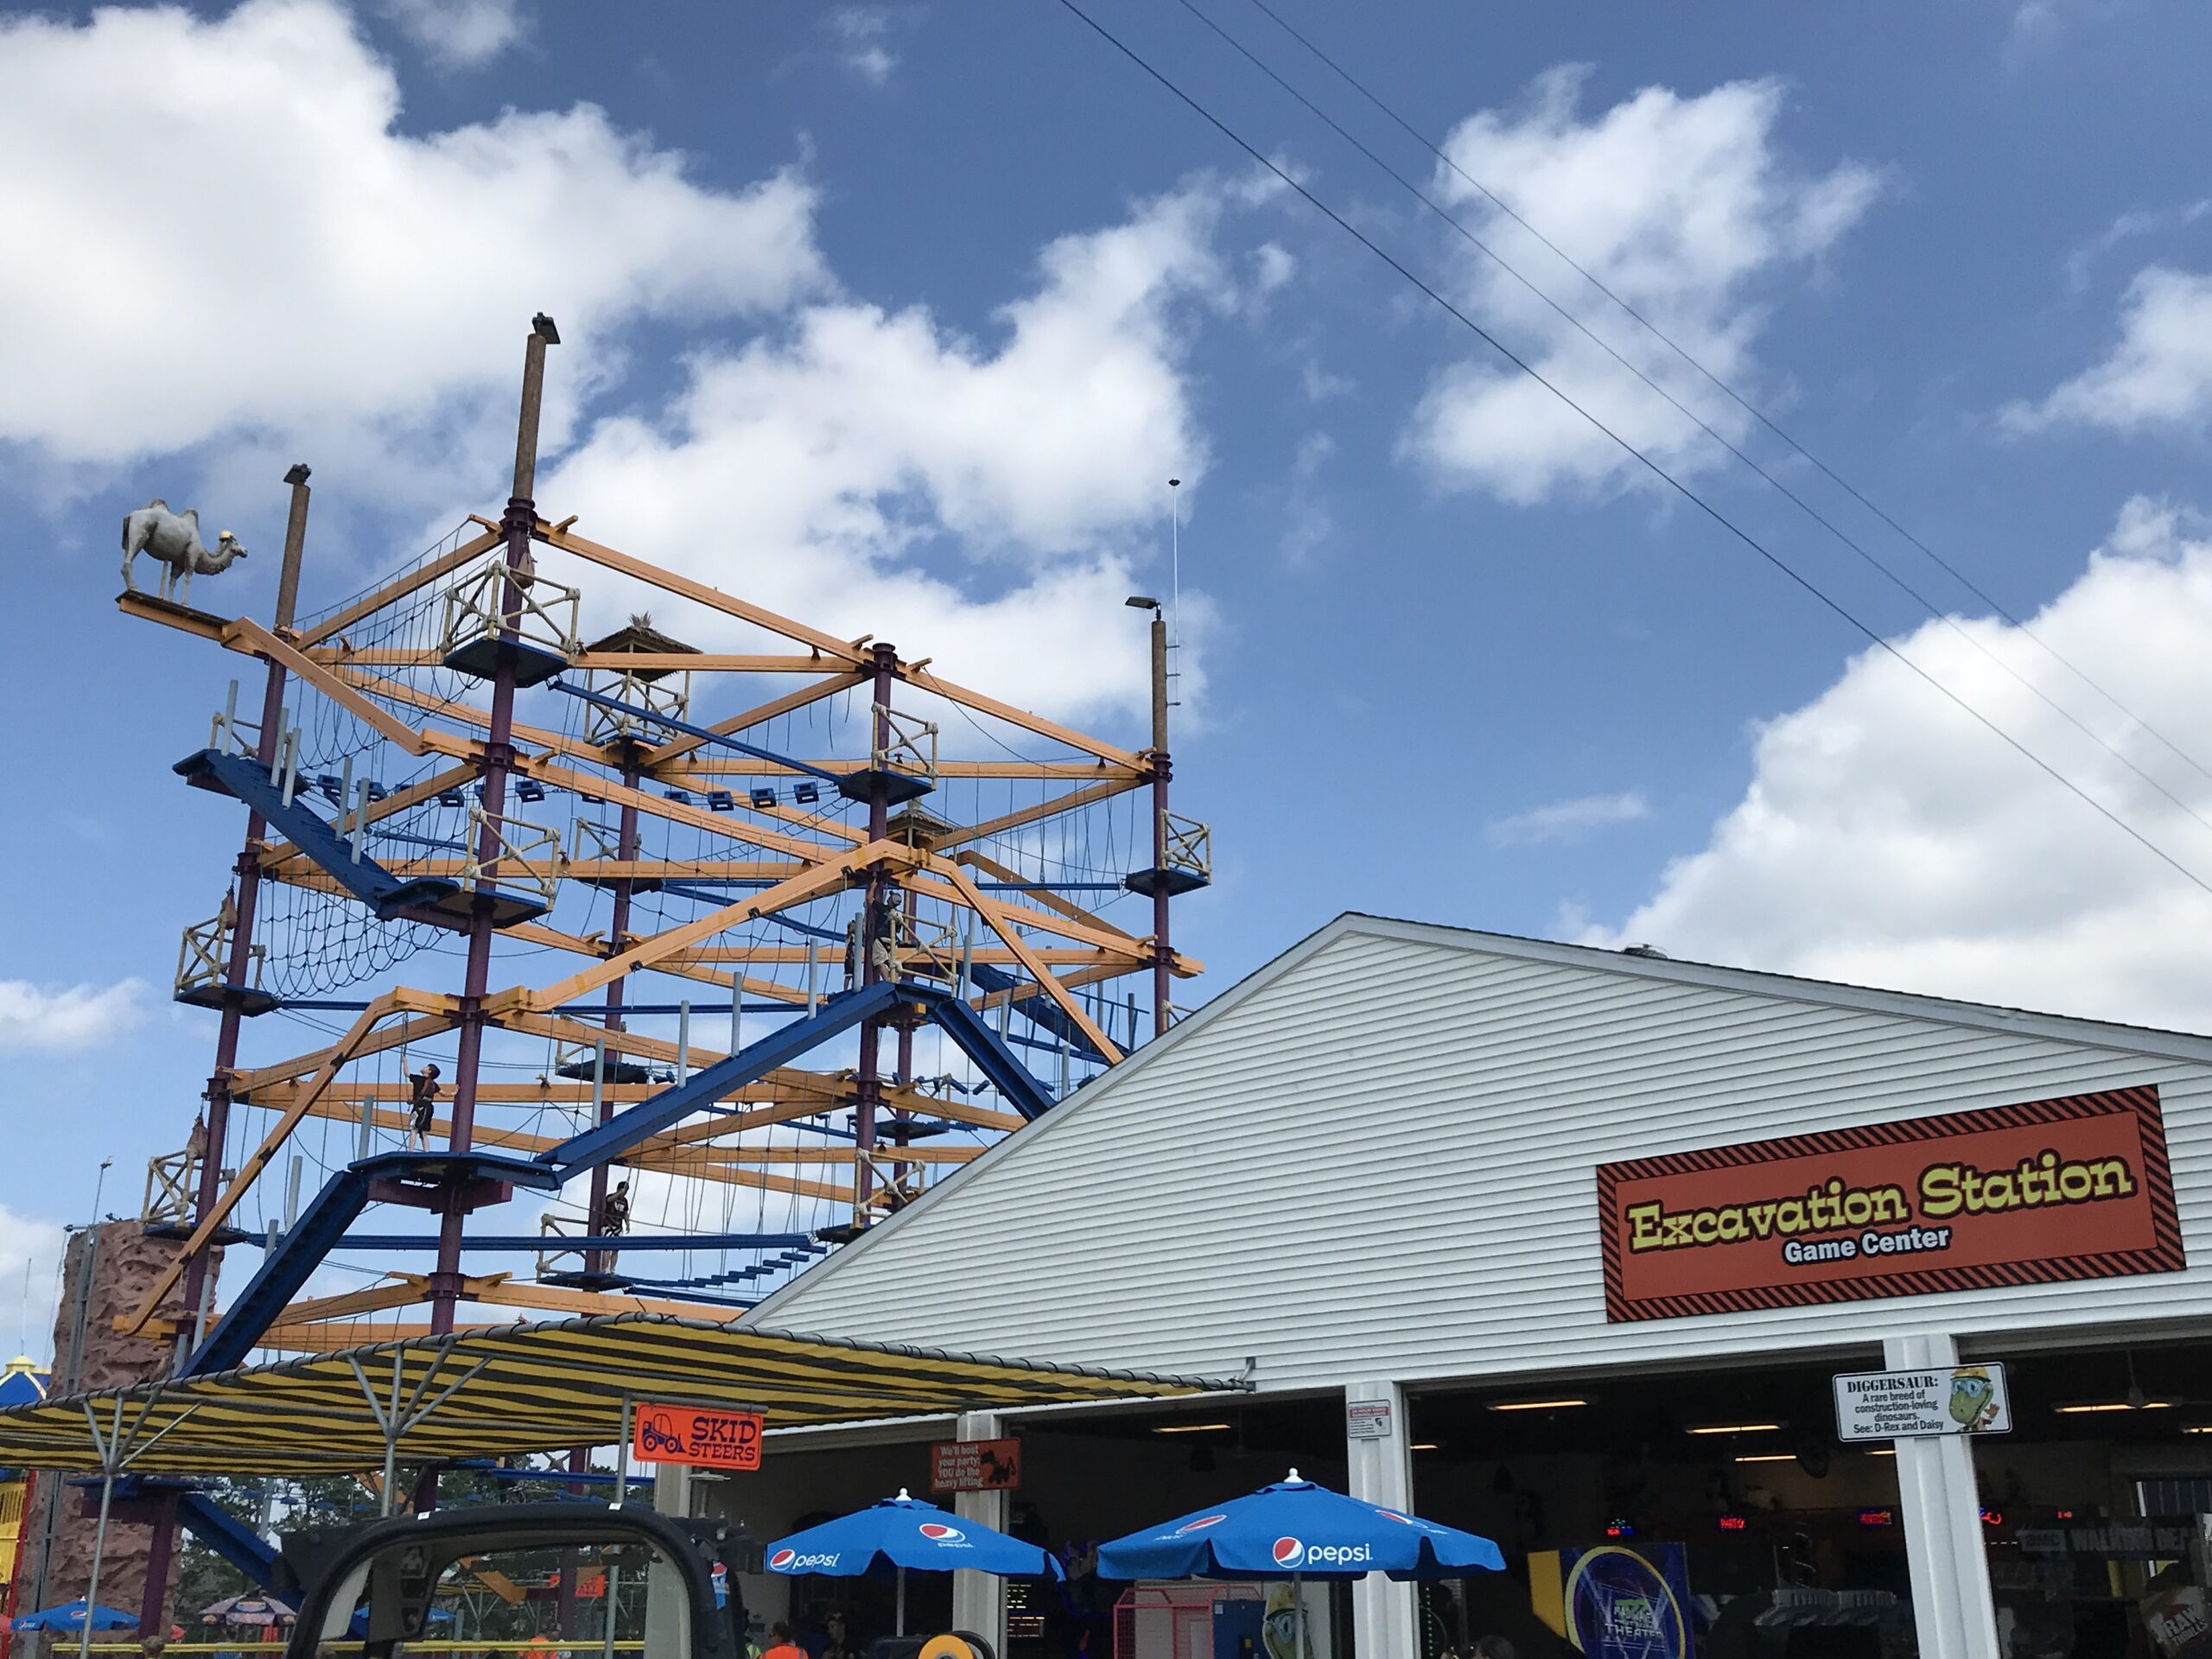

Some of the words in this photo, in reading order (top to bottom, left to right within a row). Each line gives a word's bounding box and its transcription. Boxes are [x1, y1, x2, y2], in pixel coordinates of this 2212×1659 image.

[1625, 1178, 1909, 1250] Excavation
[1919, 1153, 2134, 1215] Station
[1783, 1236, 1856, 1264] Game
[1861, 1226, 1950, 1255] Center
[1847, 1375, 1939, 1394] DIGGERSAUR:
[1862, 1394, 1870, 1402] A
[1871, 1392, 1889, 1402] rare
[1890, 1389, 1915, 1401] breed
[1916, 1389, 1926, 1399] of
[1854, 1400, 1939, 1414] construction-loving
[1873, 1412, 1920, 1422] dinosaurs.
[691, 1416, 757, 1444] SKID
[1853, 1423, 1874, 1433] See:
[1874, 1421, 1899, 1433] D-Rex
[1900, 1420, 1918, 1431] and
[1919, 1419, 1944, 1431] Daisy
[689, 1441, 756, 1462] STEERS
[939, 1445, 960, 1456] We'll
[960, 1444, 979, 1455] host
[938, 1457, 956, 1468] your
[938, 1468, 955, 1478] YOU
[955, 1467, 966, 1478] do
[966, 1466, 981, 1477] the
[935, 1478, 959, 1489] heavy
[792, 1552, 840, 1570] pepsi
[1307, 1542, 1370, 1566] pepsi
